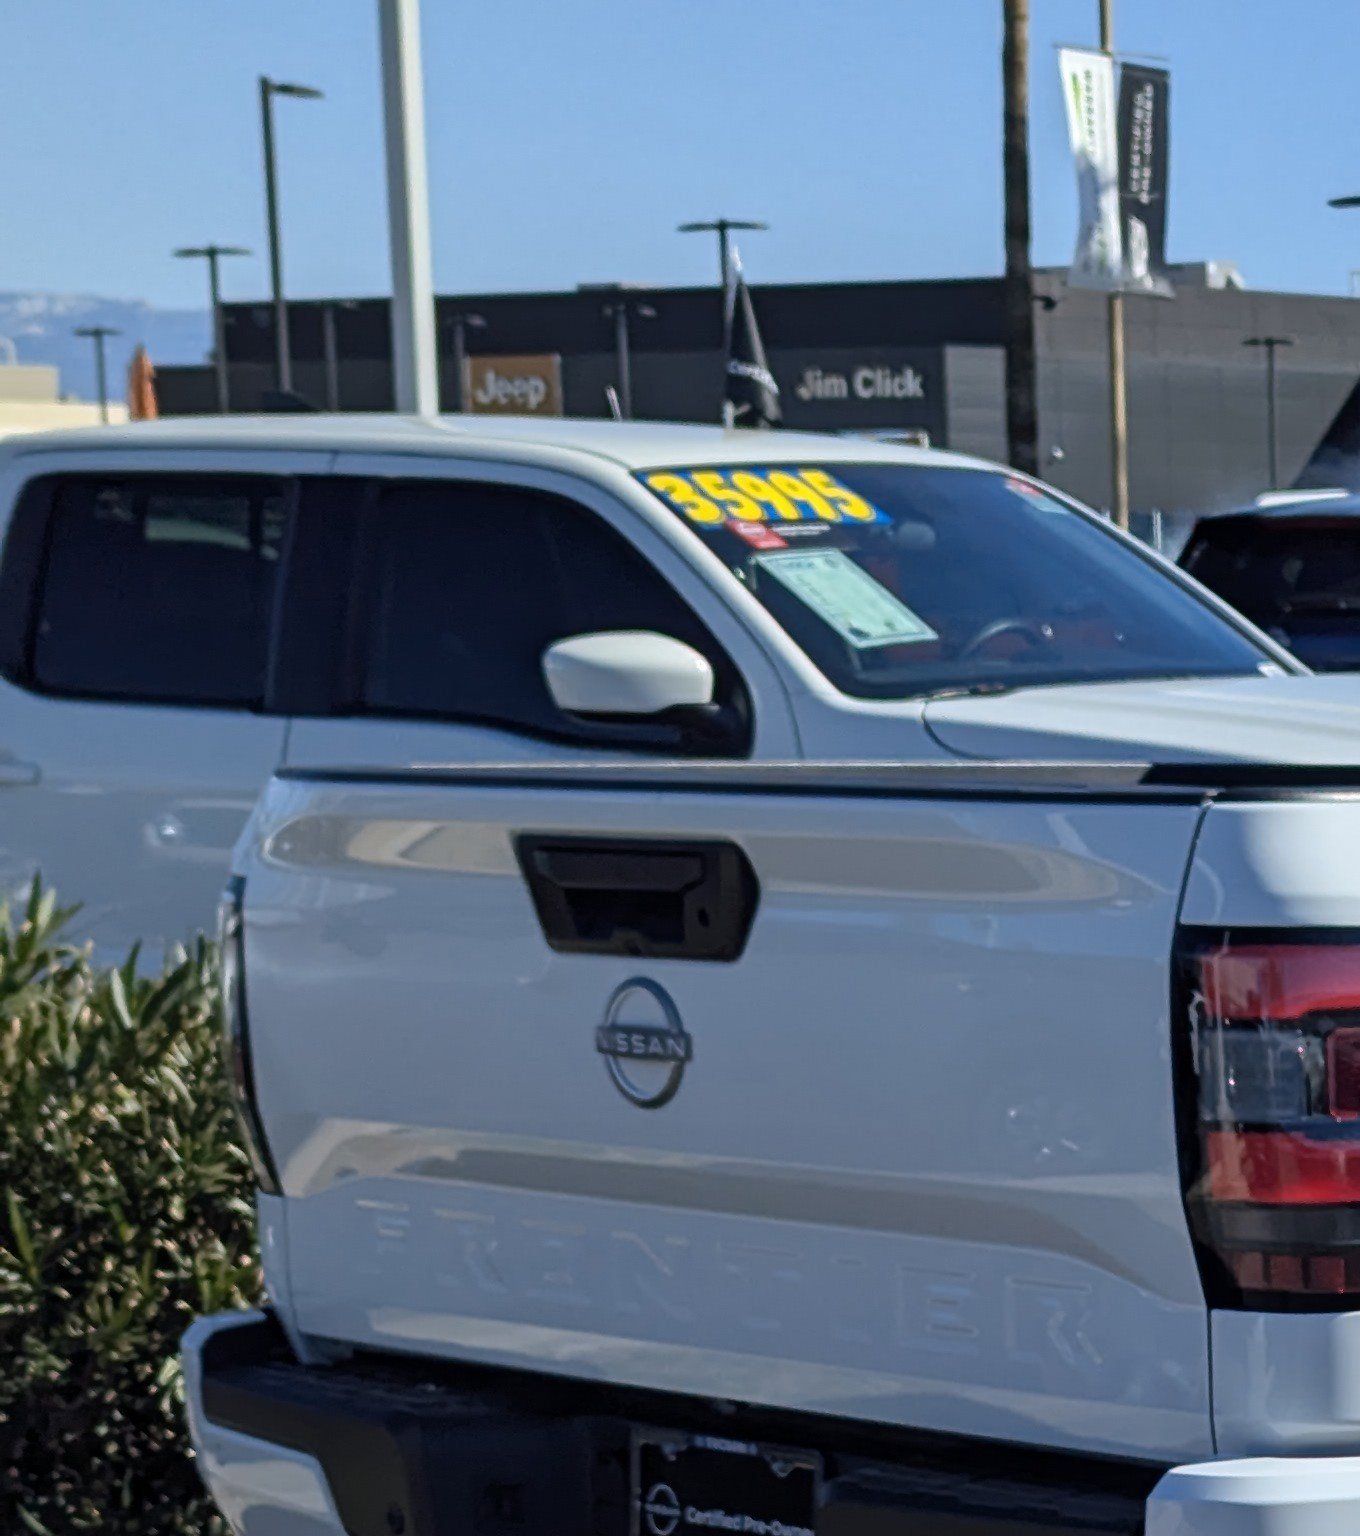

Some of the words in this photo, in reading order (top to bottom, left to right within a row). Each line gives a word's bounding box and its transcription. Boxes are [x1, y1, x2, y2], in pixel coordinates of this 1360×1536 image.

[474, 367, 547, 411] Jeep
[795, 365, 849, 402] Jim
[852, 364, 925, 398] Click
[645, 467, 877, 526] 35995
[597, 1028, 687, 1061] NISSAN
[684, 1504, 745, 1532] Certified
